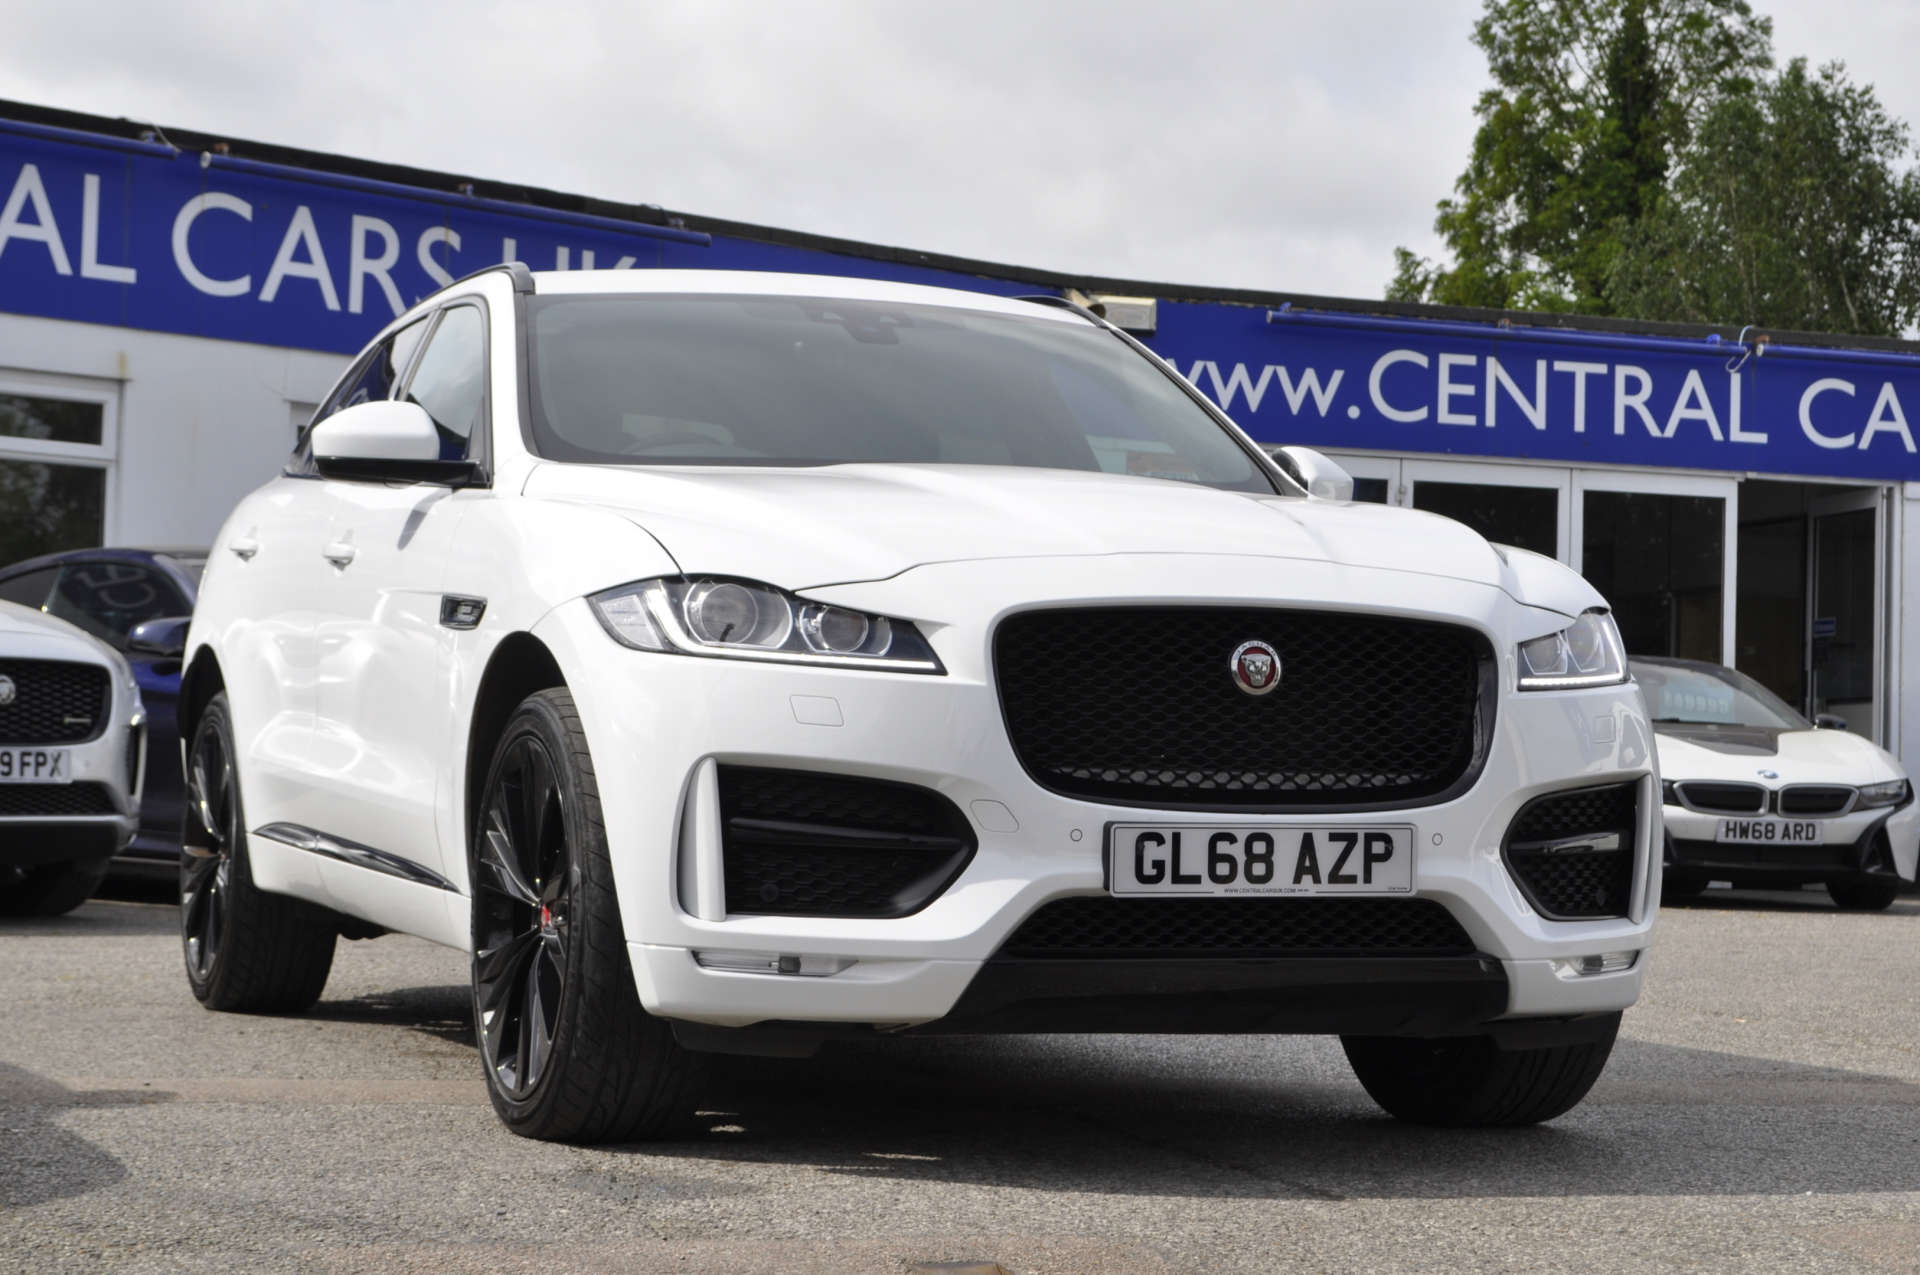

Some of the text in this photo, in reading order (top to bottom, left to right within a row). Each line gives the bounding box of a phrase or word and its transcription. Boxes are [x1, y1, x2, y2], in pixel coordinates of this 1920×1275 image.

[0, 163, 461, 317] AL CARS
[1798, 378, 1918, 453] CA
[20, 752, 62, 778] FPX
[1134, 831, 1394, 885] GL68 AZP
[1725, 821, 1816, 841] HW68 ARD
